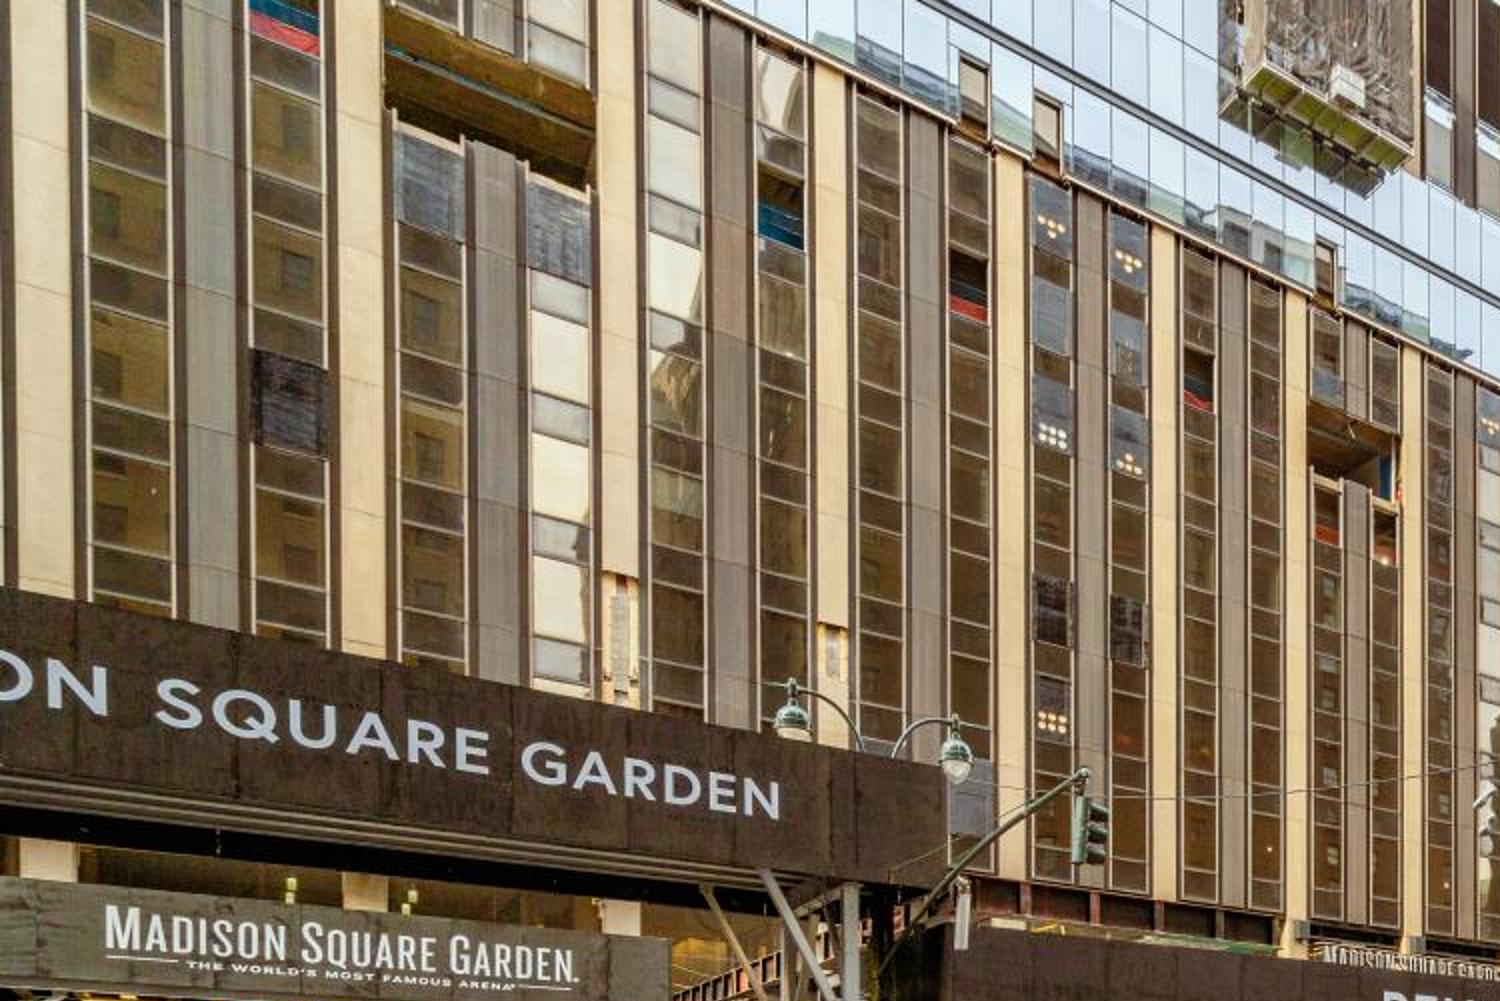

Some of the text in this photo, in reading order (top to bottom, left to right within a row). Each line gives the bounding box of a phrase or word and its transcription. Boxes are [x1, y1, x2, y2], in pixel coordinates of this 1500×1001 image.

[155, 678, 490, 775] SQUARE
[521, 741, 780, 820] GARDEN
[105, 904, 287, 962] MADISON
[301, 921, 437, 973] SQUARE
[186, 960, 224, 971] THE
[232, 962, 318, 978] WORLD'S
[325, 970, 375, 983] MOST
[383, 973, 453, 988] FAMOUS
